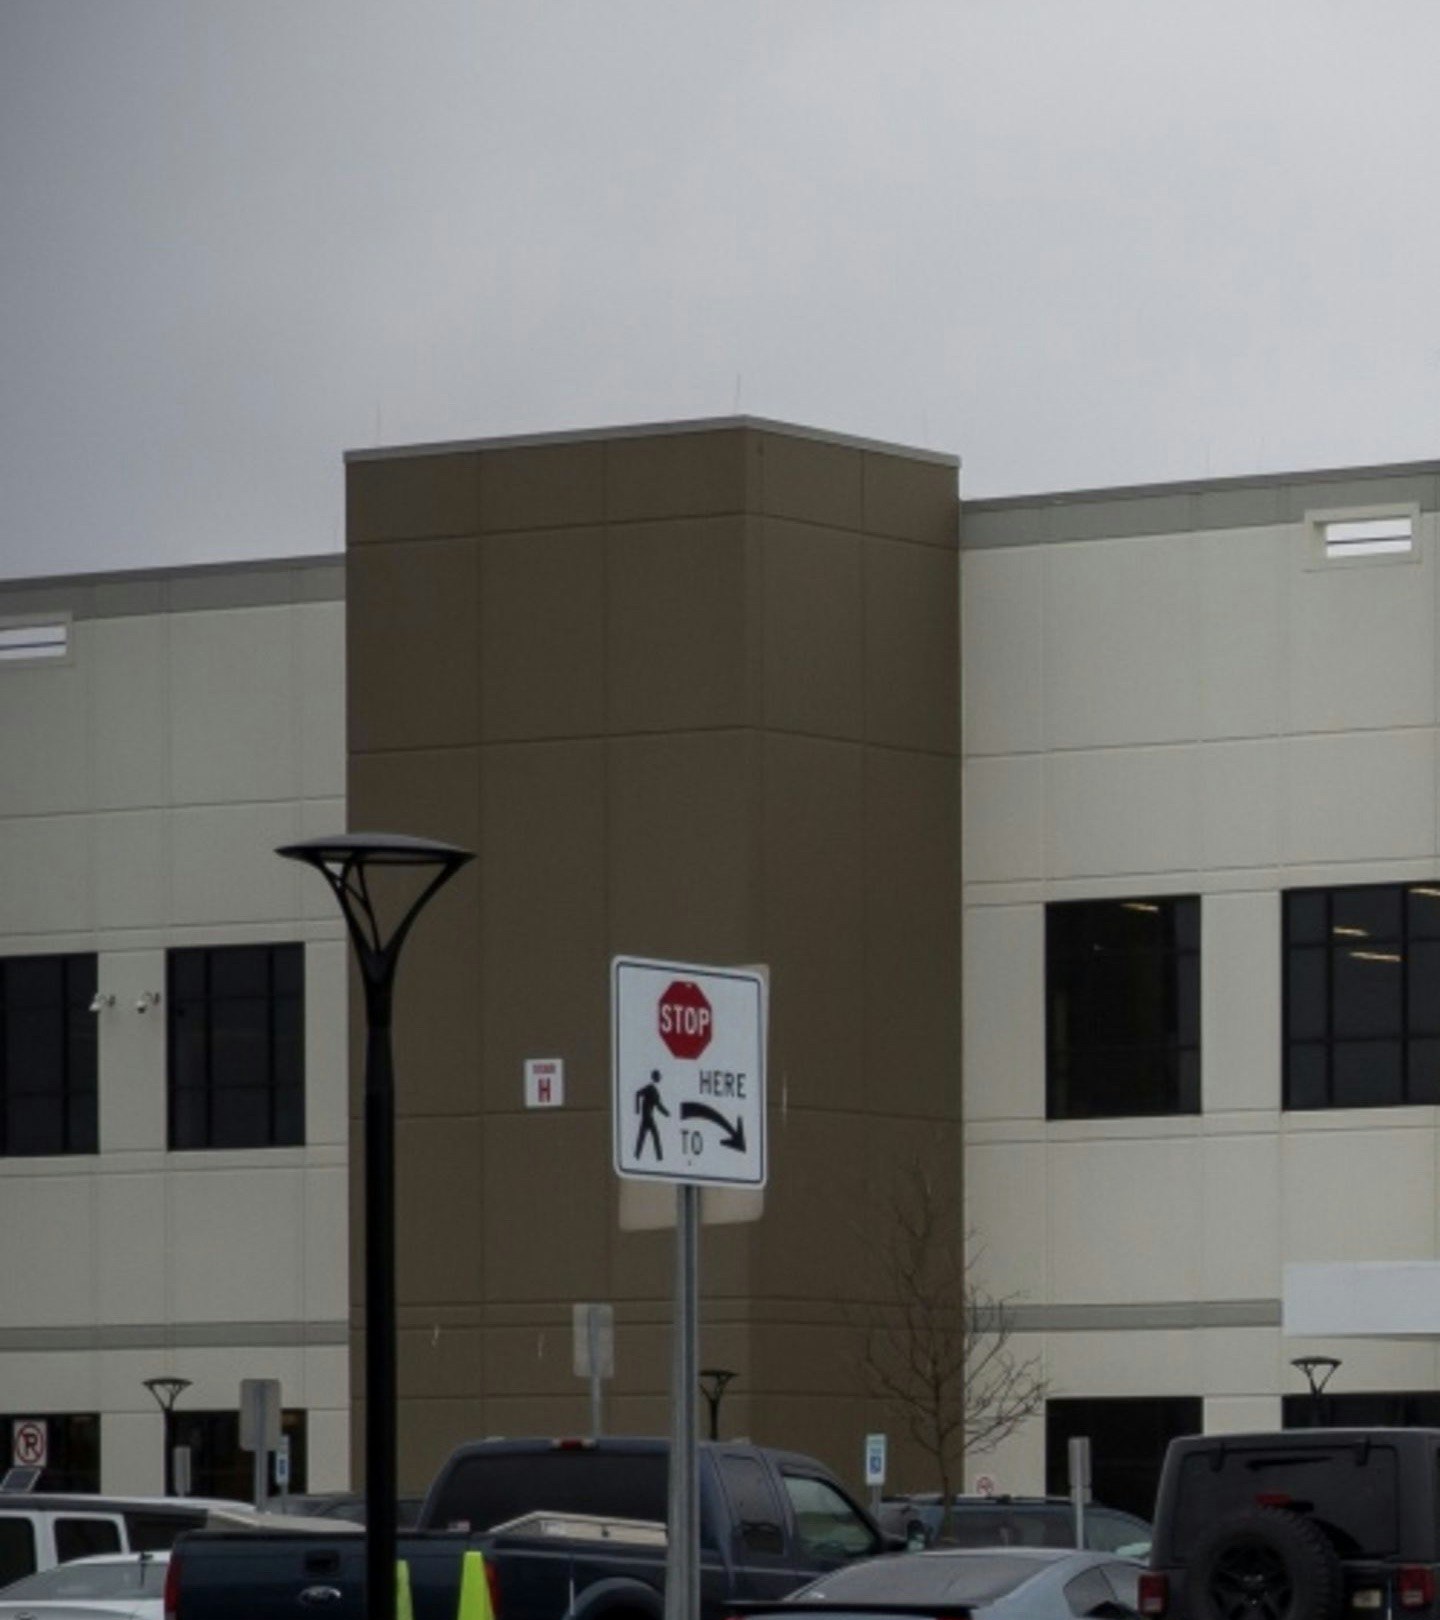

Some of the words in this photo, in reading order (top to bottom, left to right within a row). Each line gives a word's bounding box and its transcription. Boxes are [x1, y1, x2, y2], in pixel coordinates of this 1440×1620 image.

[661, 1004, 710, 1035] STOP
[699, 1069, 746, 1099] HERE
[681, 1129, 703, 1155] TO
